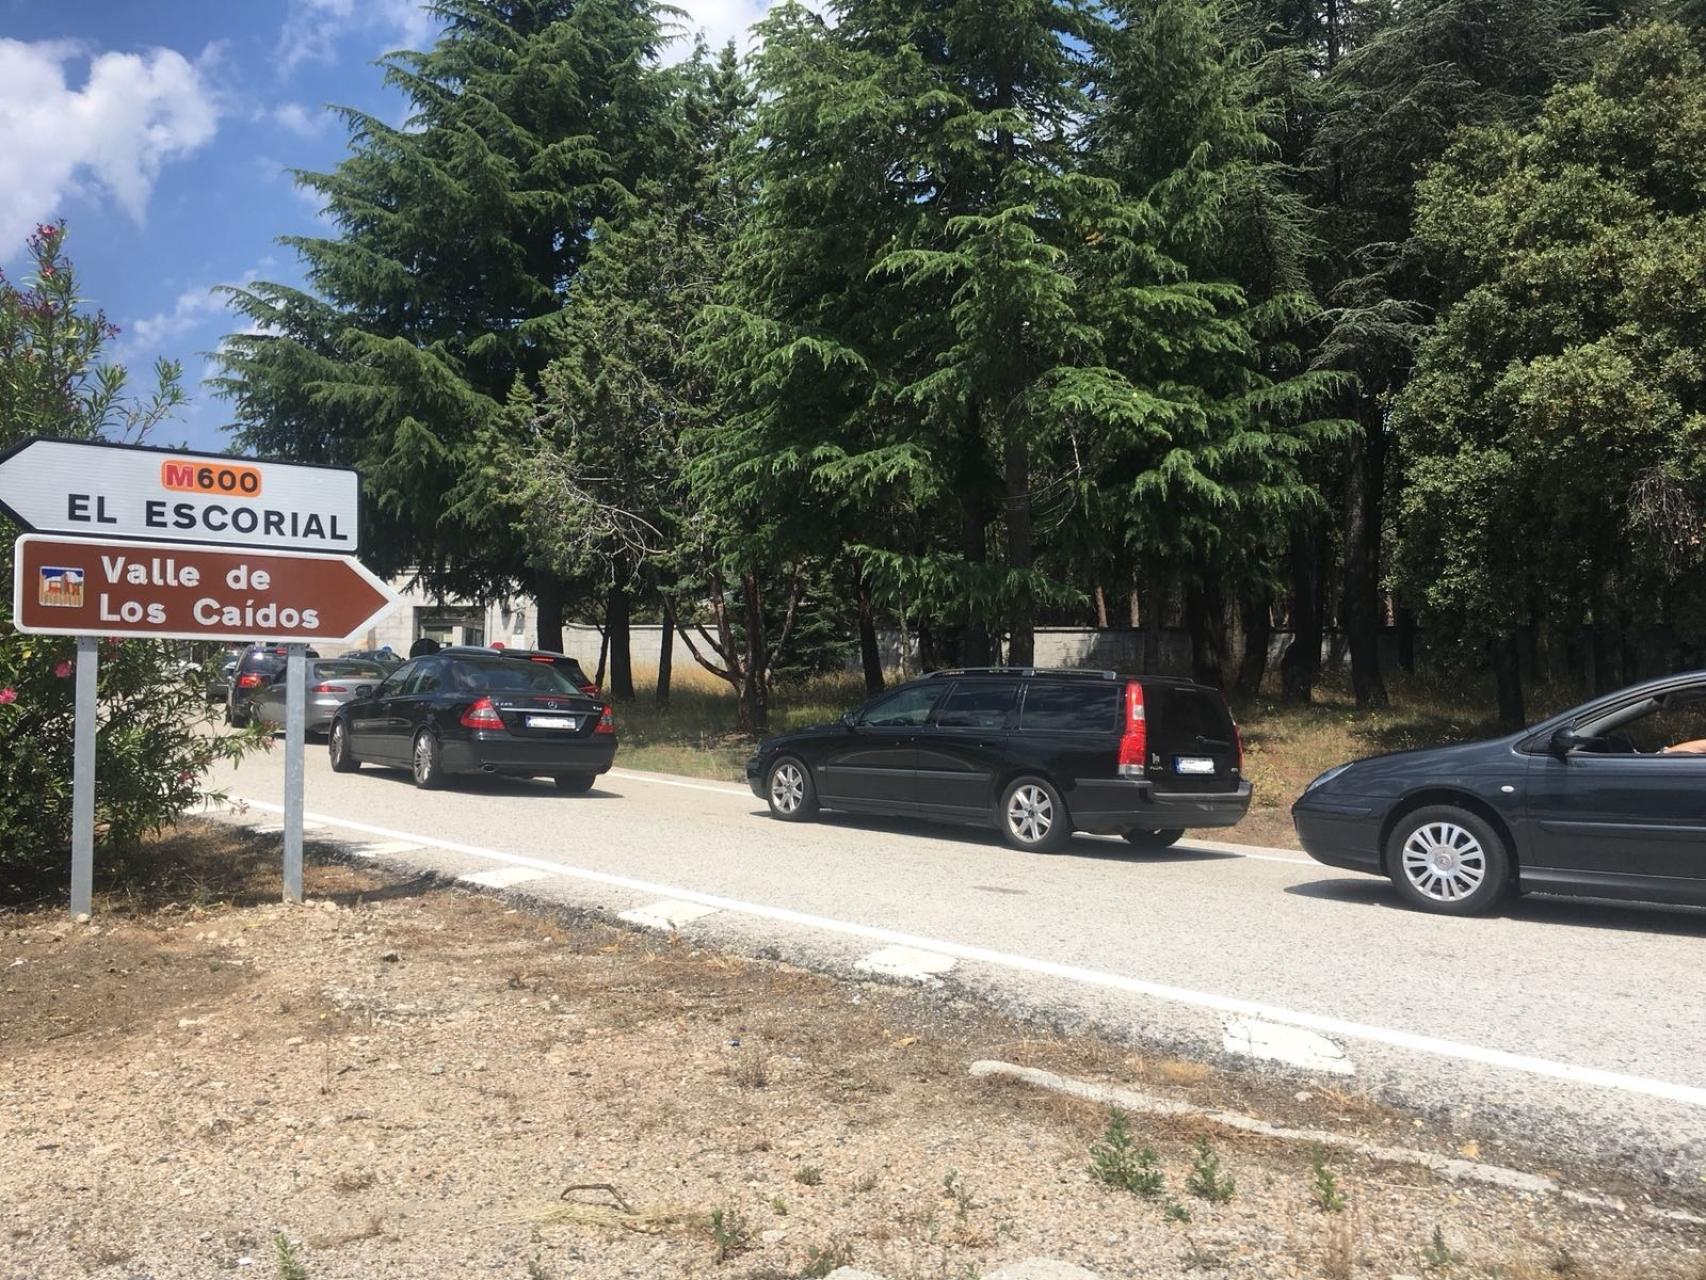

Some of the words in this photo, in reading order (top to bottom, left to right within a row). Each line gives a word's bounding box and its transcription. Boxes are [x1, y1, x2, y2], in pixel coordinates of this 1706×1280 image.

[165, 464, 259, 493] M600
[68, 493, 117, 524] EL
[145, 500, 348, 540] ESCORIAL
[101, 555, 200, 587] Valle
[226, 564, 270, 590] de
[99, 594, 166, 624] Los
[193, 597, 320, 629] Caídos
